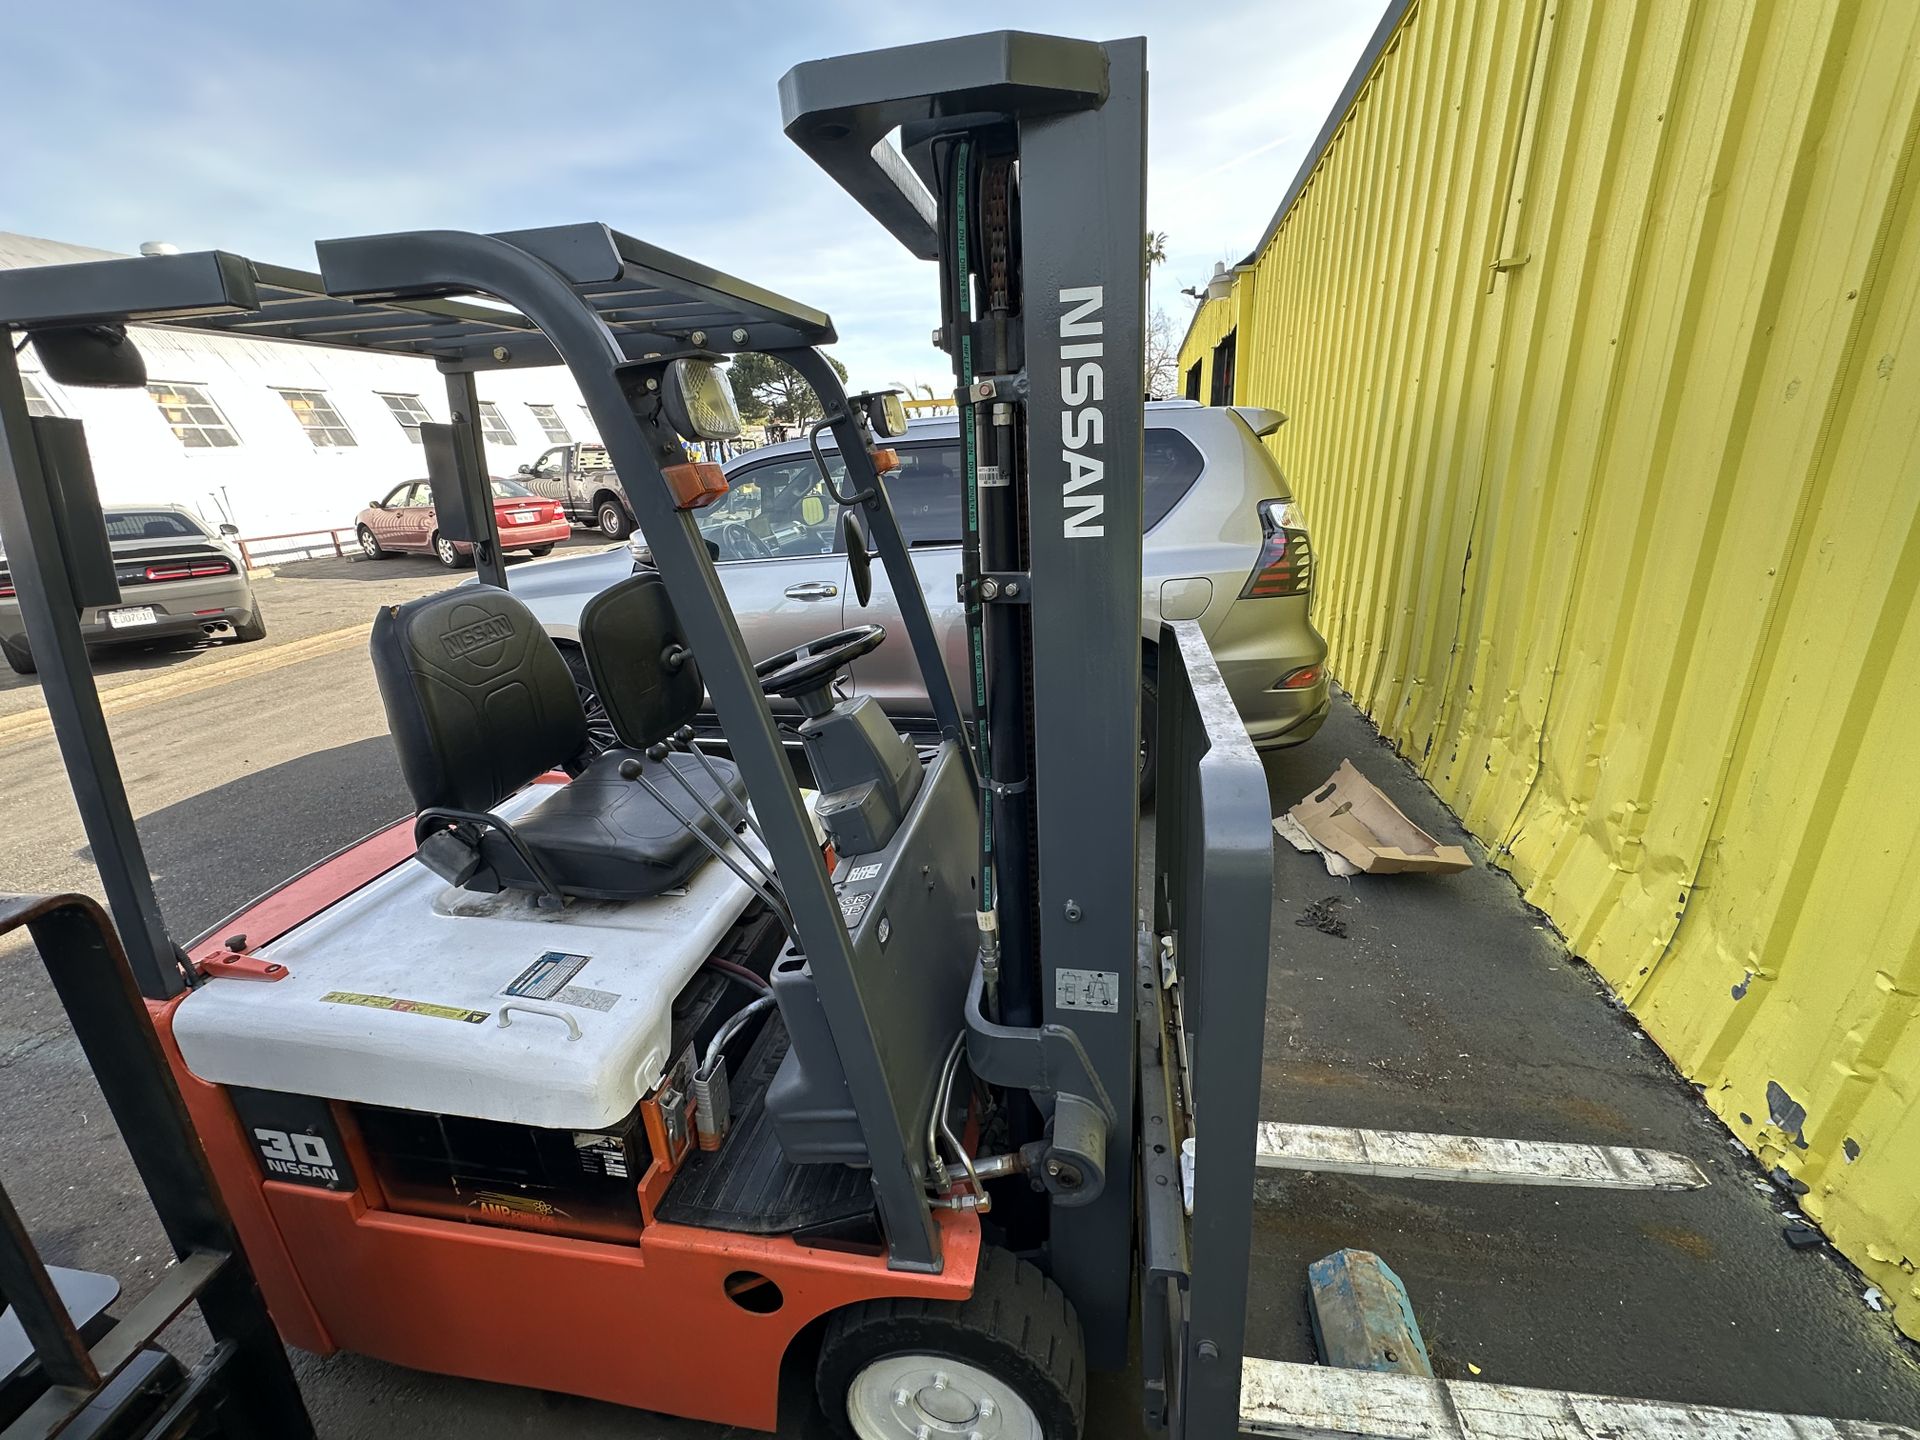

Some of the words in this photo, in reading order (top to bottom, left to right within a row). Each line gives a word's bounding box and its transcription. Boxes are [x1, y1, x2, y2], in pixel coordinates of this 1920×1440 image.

[958, 229, 966, 251] DN12
[1059, 285, 1105, 539] NISSAN
[443, 617, 511, 657] NISSAN
[253, 1127, 333, 1167] 30
[266, 1158, 340, 1181] NISSAN
[480, 1202, 510, 1217] AMP
